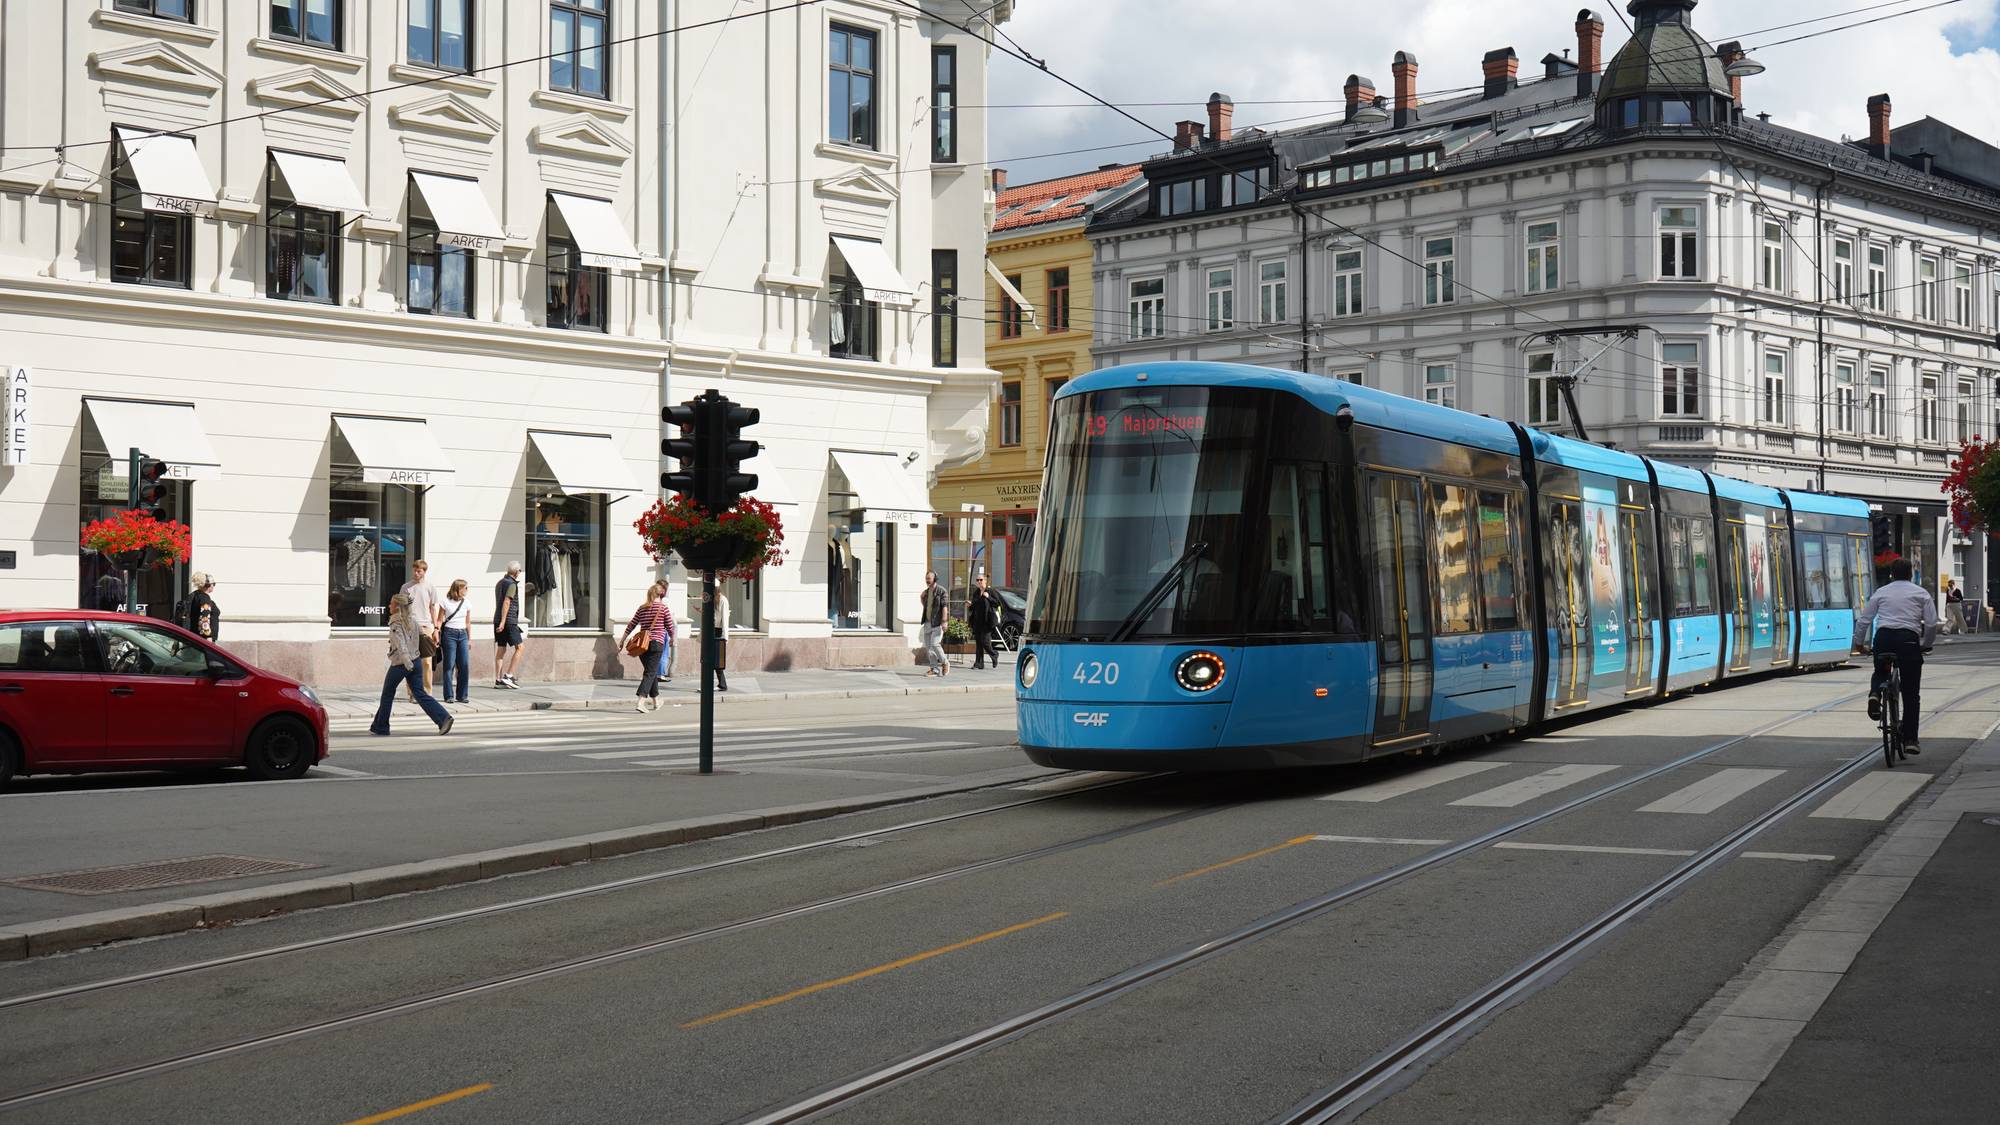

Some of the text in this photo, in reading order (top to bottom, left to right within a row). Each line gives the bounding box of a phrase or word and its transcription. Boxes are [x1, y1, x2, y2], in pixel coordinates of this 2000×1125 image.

[155, 197, 203, 212] ARKET
[450, 235, 491, 249] ARKET
[593, 255, 629, 269] ARKET
[874, 291, 903, 303] ARKET
[14, 368, 28, 463] ARKET
[1087, 414, 1204, 436] 19 Majorstuen
[161, 465, 191, 478] KET
[389, 471, 431, 483] ARKET
[996, 484, 1042, 495] VALKYRIEN
[885, 511, 915, 522] ARKET
[116, 603, 149, 613] ARET
[359, 606, 386, 615] ARKET
[1072, 662, 1120, 685] 420
[1073, 712, 1110, 727] CAF
